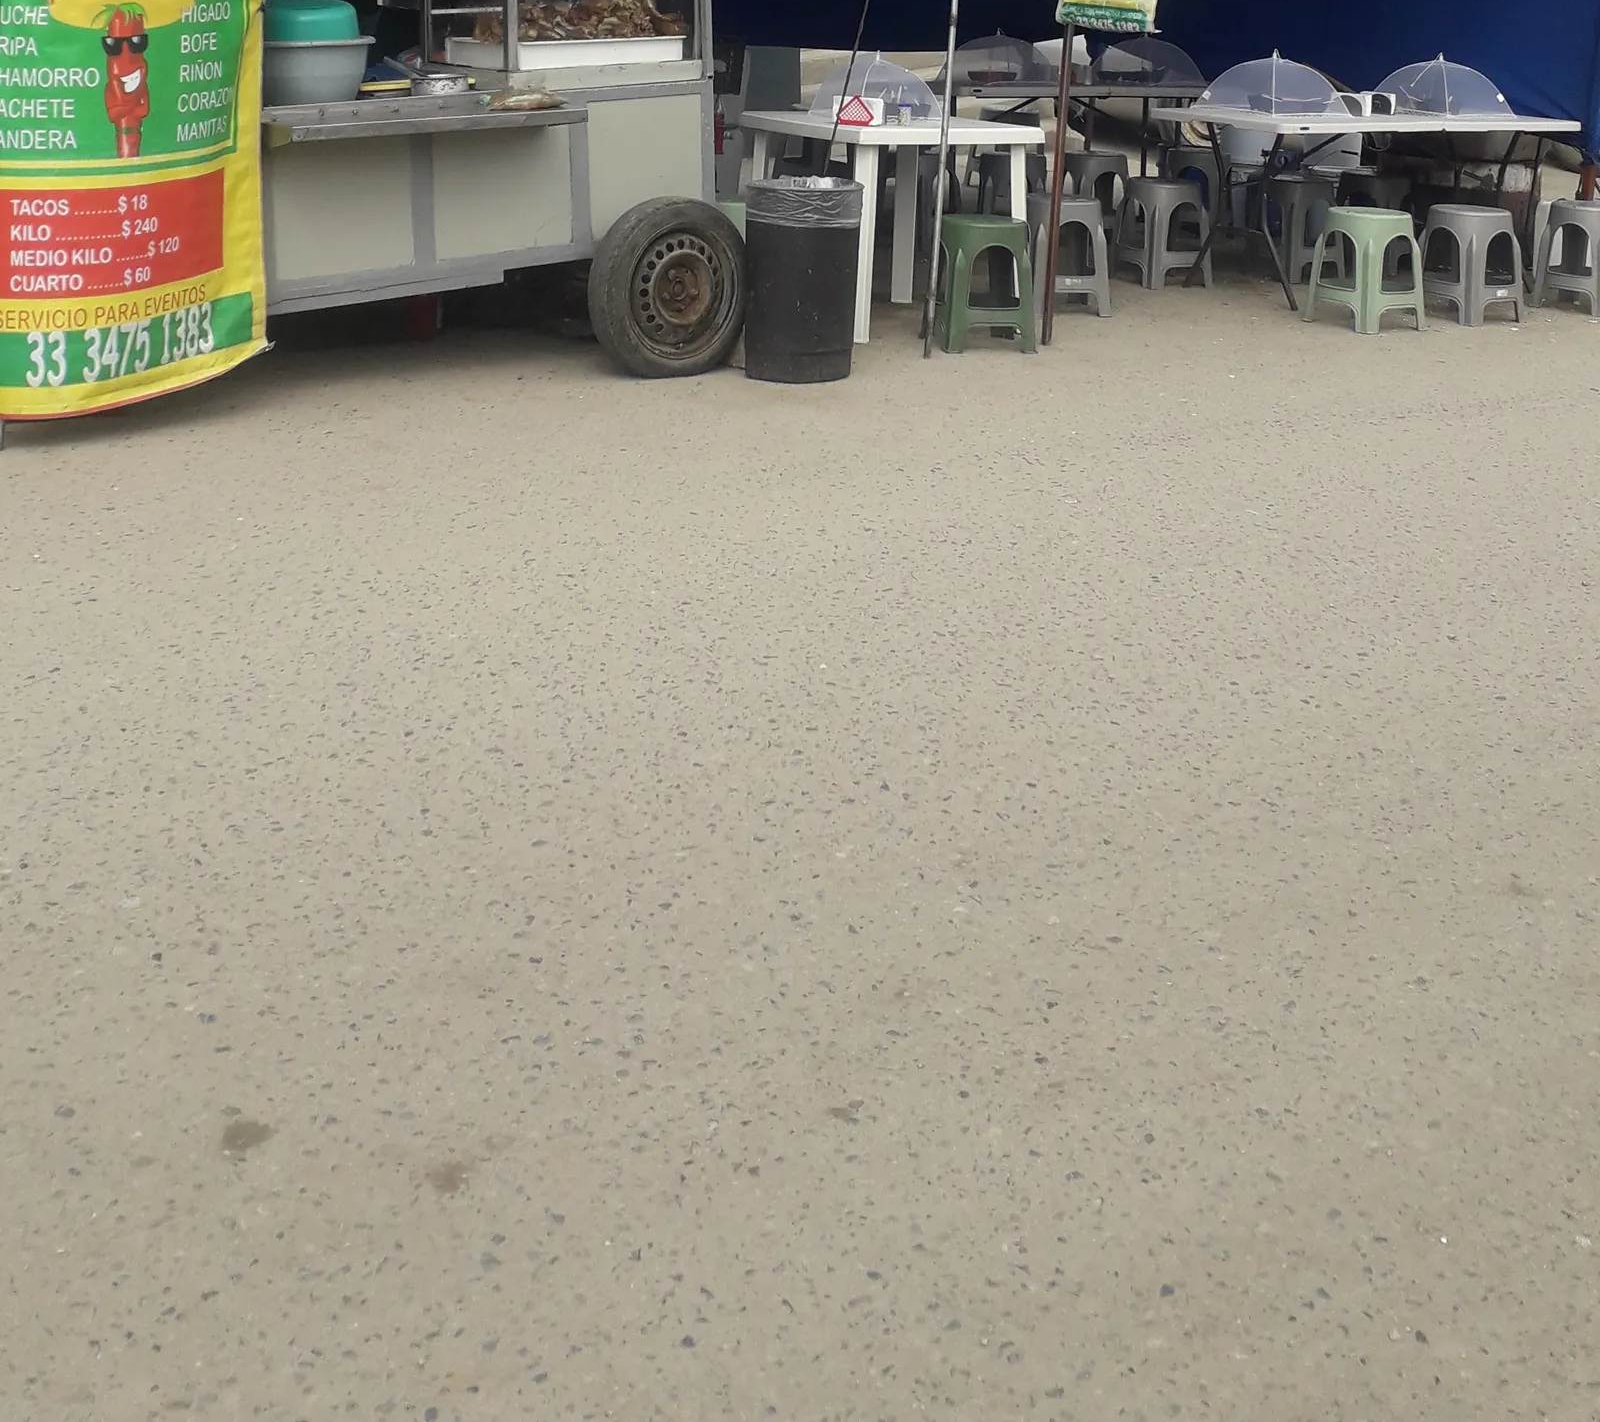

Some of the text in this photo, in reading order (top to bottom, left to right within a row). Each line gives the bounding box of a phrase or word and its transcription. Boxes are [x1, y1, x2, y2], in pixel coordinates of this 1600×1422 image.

[180, 2, 231, 24] HIGADO
[180, 32, 218, 55] BOFE
[180, 59, 223, 83] RIÑON
[177, 86, 232, 113] CORAZO
[176, 115, 228, 143] MANITAS
[10, 199, 70, 216] TACOS
[10, 224, 51, 242] KILO
[134, 217, 158, 236] 240
[10, 249, 68, 267] MEDIO
[72, 247, 112, 266] KILO
[159, 236, 180, 254] 120
[10, 274, 83, 293] CUARTO
[94, 301, 139, 326] PARA
[146, 284, 206, 317] EVENTOS
[26, 302, 215, 387] 33 3475 1383
